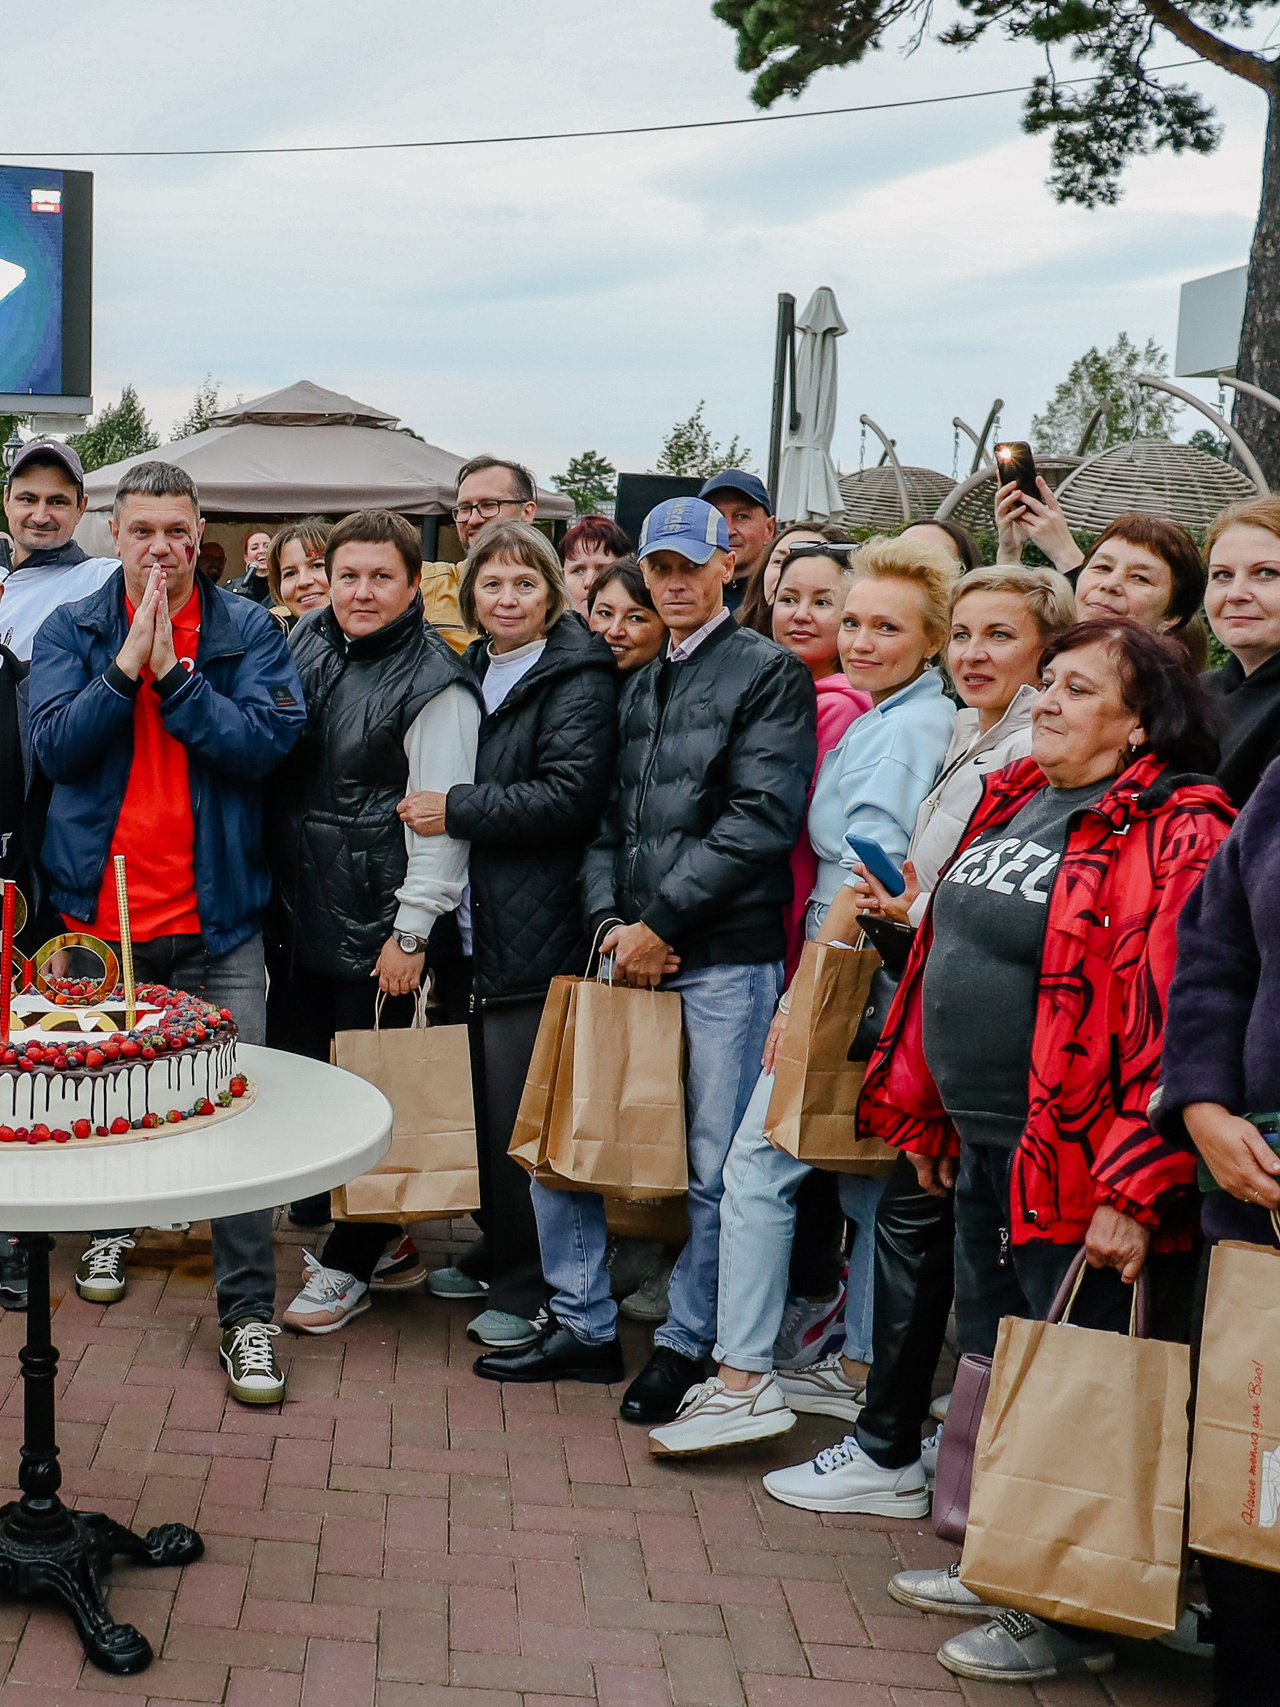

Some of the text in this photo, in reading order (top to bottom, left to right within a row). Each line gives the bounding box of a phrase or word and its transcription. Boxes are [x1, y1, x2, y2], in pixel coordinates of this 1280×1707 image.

[1251, 1402, 1264, 1430] для
[1249, 1432, 1260, 1477] тепло
[1241, 1479, 1257, 1526] Наше
